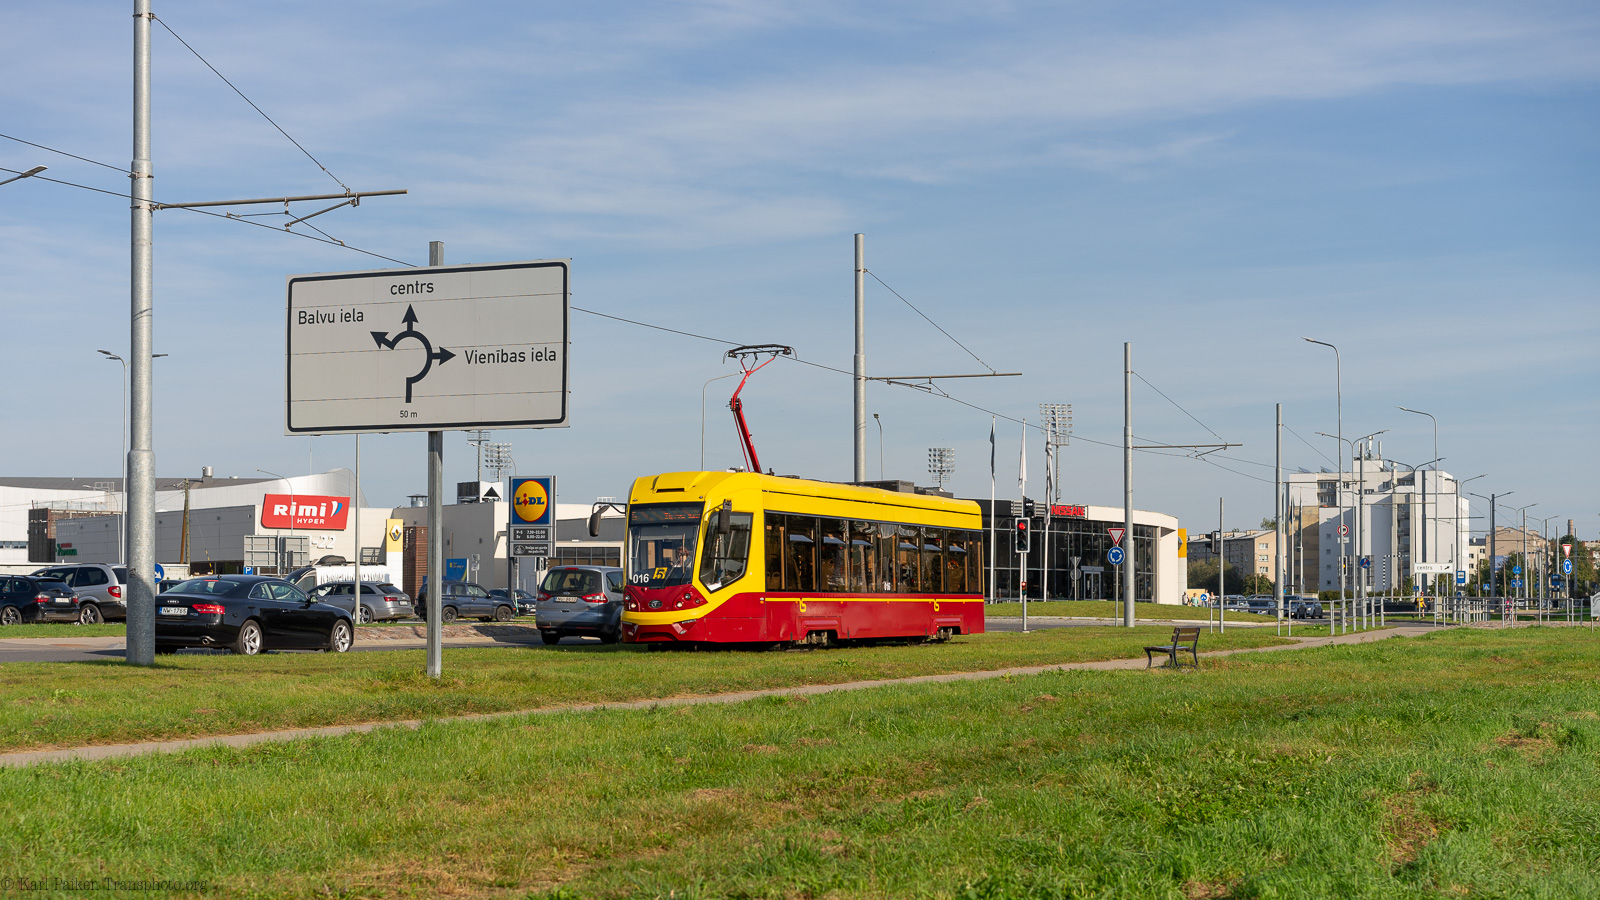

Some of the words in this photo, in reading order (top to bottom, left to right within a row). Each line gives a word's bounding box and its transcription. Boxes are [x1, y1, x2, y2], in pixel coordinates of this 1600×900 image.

[390, 280, 434, 295] centrs
[298, 310, 336, 325] Balvu
[340, 308, 364, 323] iela
[465, 348, 526, 365] Vienības
[531, 347, 557, 362] iela
[399, 410, 409, 418] 50
[516, 493, 545, 507] LIDL
[273, 502, 326, 517] Rimi
[1050, 504, 1085, 516] NISSAN
[245, 566, 252, 574] P
[632, 573, 650, 584] 016
